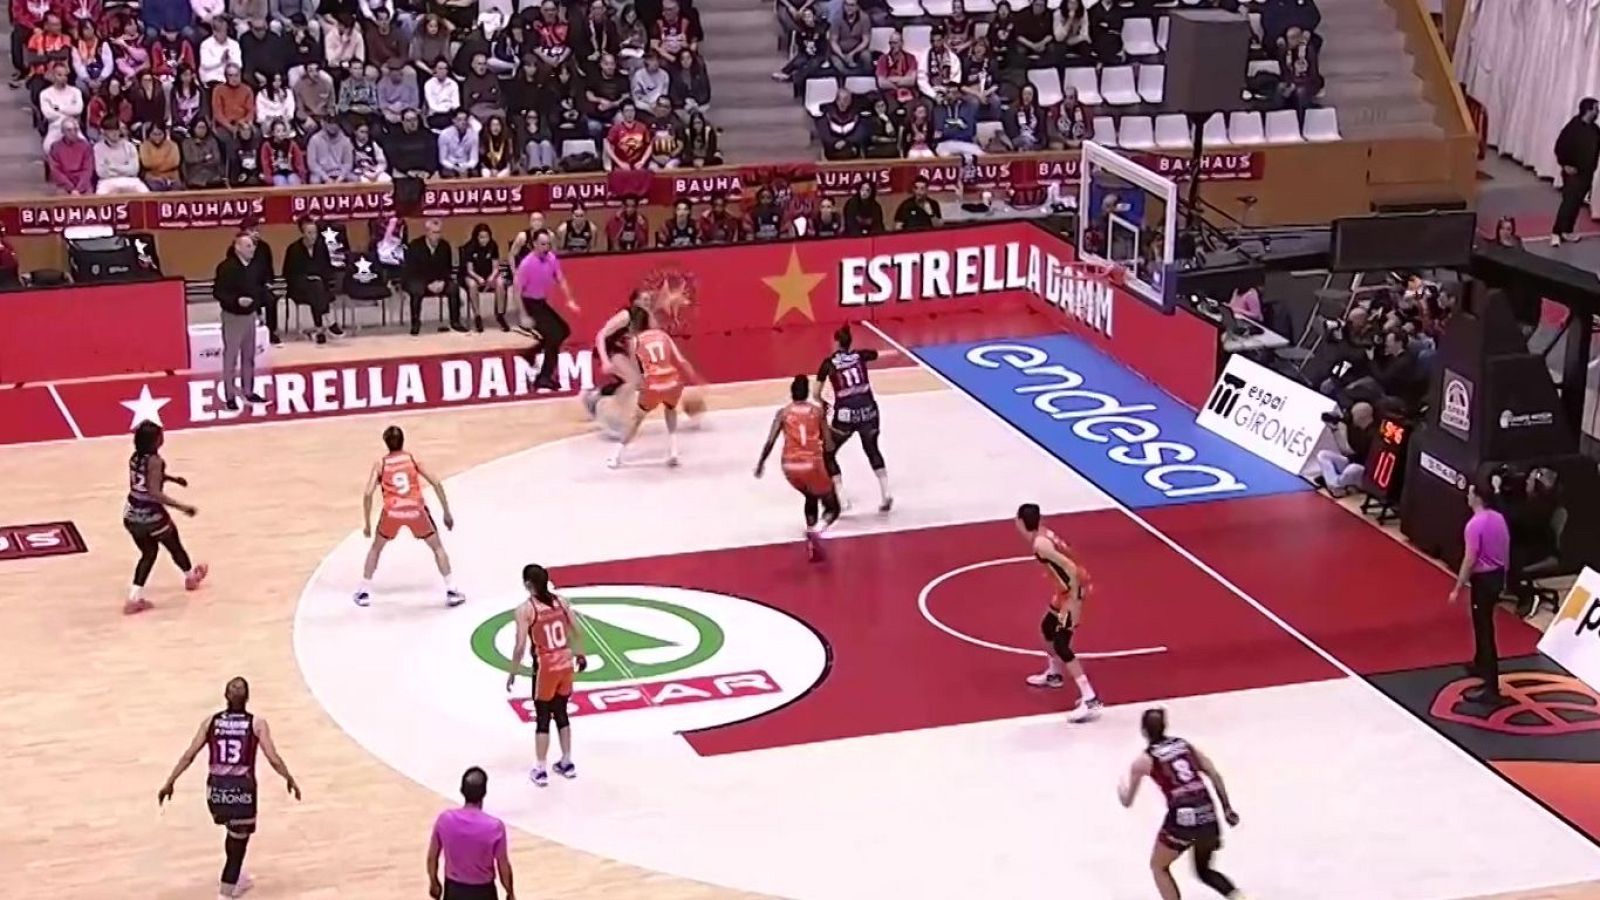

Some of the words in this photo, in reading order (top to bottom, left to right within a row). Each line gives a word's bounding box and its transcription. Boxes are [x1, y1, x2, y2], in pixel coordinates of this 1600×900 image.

[1160, 152, 1251, 171] BAHAUS
[816, 168, 891, 185] AUHAUS
[920, 163, 1011, 182] BAUAUS
[552, 185, 606, 199] BAUH
[675, 177, 742, 192] BAUHA
[294, 192, 394, 212] BAUHAUS
[425, 185, 522, 206] BAUHAUS
[21, 204, 129, 223] BAUHAUS
[161, 198, 264, 219] BAUHAUS
[840, 242, 1041, 306] ESTRELLA
[842, 367, 860, 386] 11
[188, 366, 427, 422] ESTRELLA
[1248, 386, 1288, 411] espai
[965, 342, 1248, 498] endesa
[392, 471, 410, 495] 9
[543, 620, 567, 649] 10
[217, 738, 242, 764] 13
